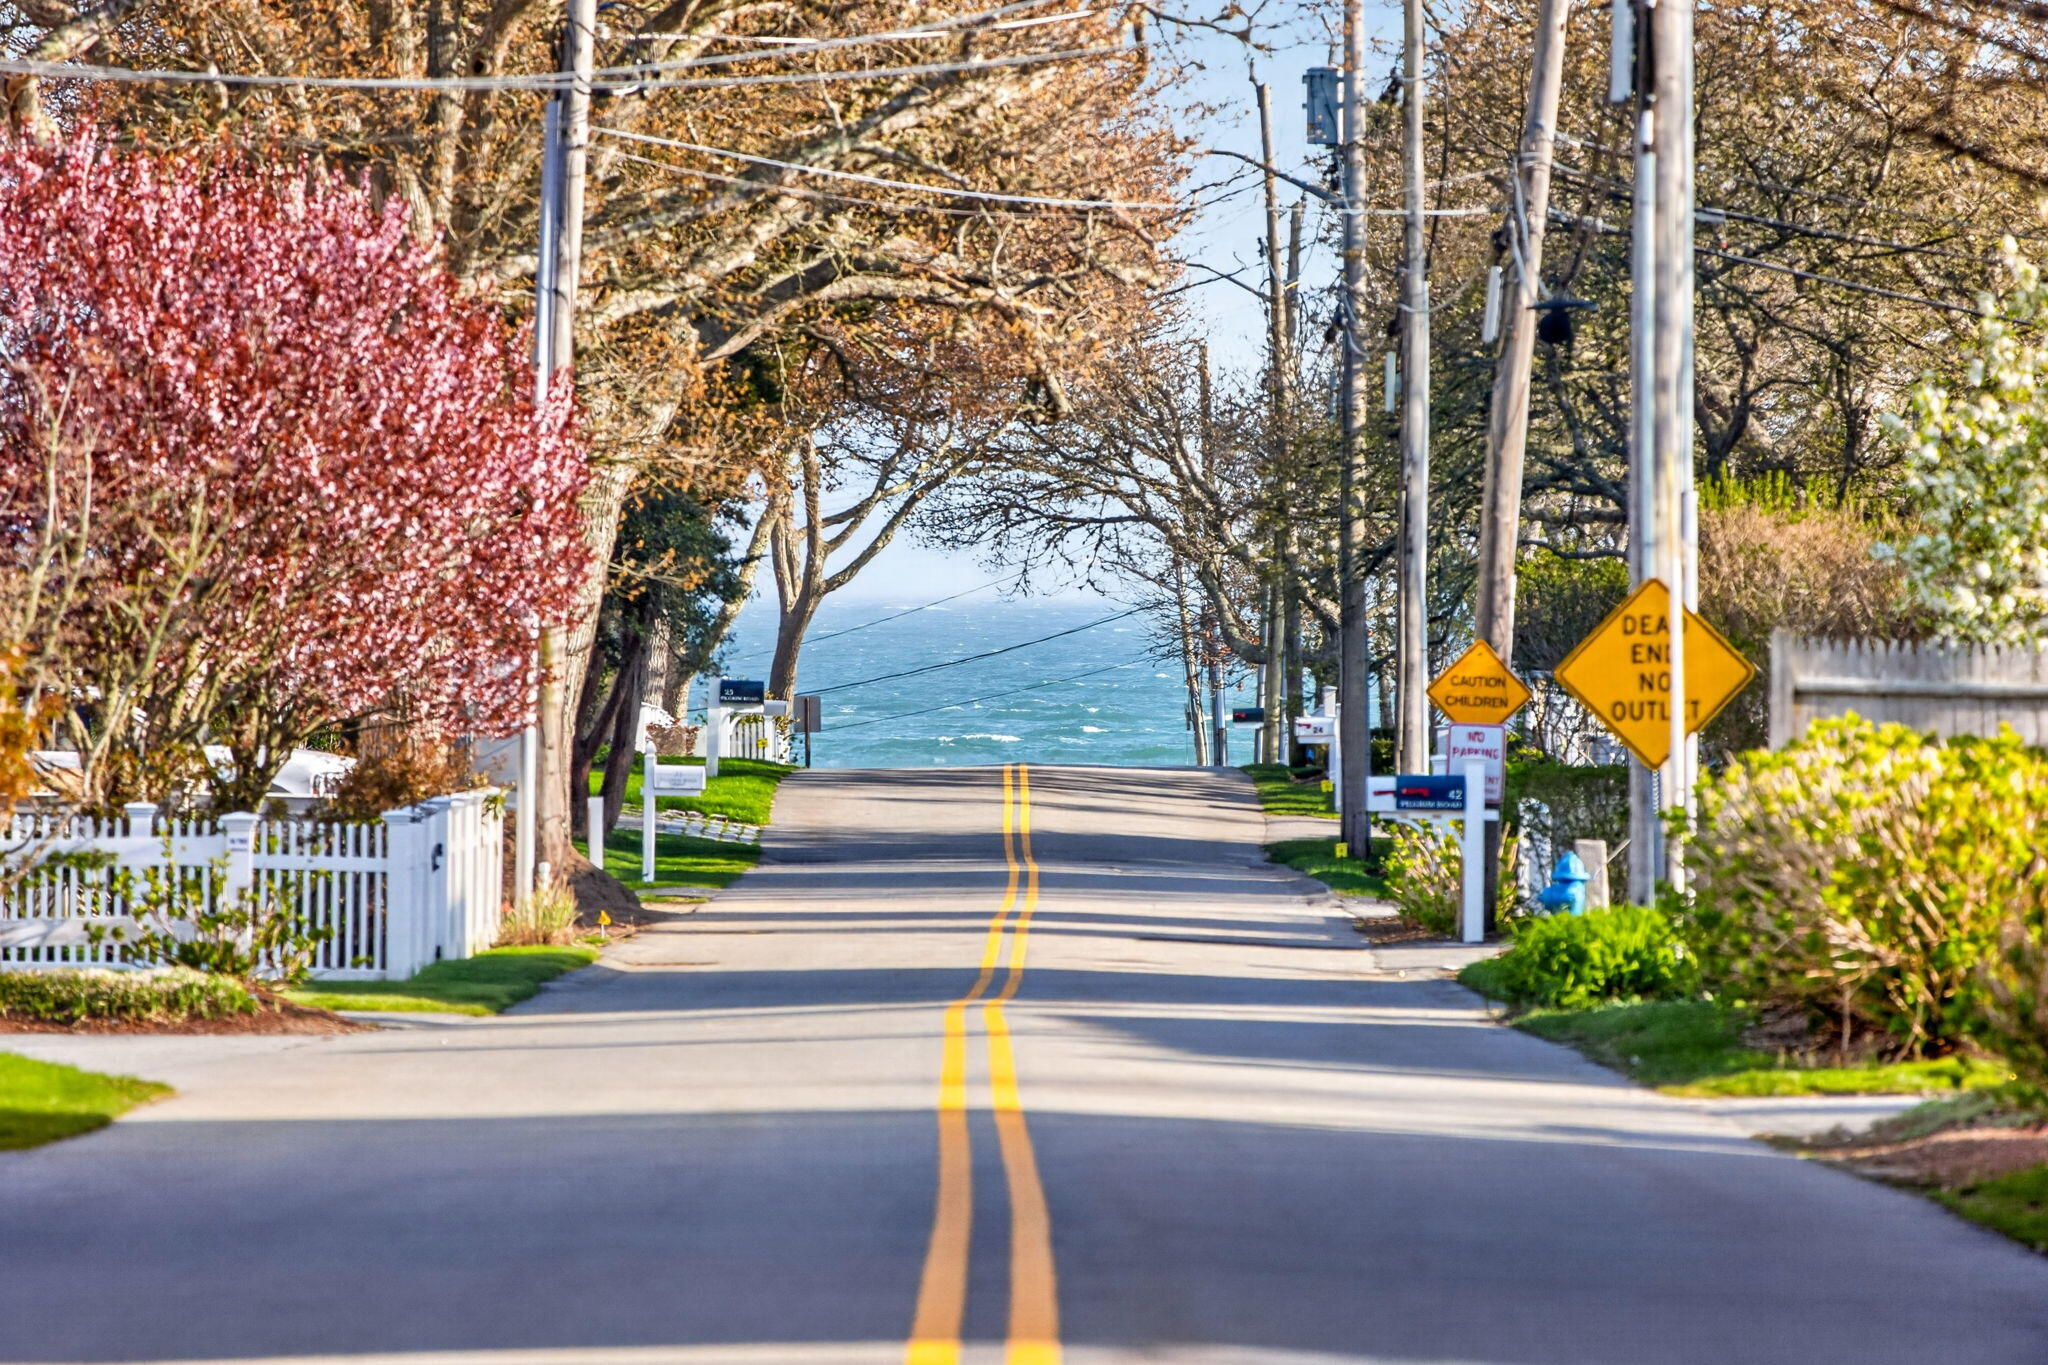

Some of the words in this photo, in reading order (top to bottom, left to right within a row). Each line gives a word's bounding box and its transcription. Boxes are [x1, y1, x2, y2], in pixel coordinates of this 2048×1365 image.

[1450, 675, 1507, 688] CAUTION
[1639, 672, 1672, 692] NO
[1444, 695, 1509, 708] CHILDREN
[1611, 700, 1701, 721] OUTLT
[1313, 726, 1324, 734] 24
[1467, 732, 1485, 742] NO
[1452, 747, 1499, 760] PARKING
[1447, 789, 1463, 800] 42
